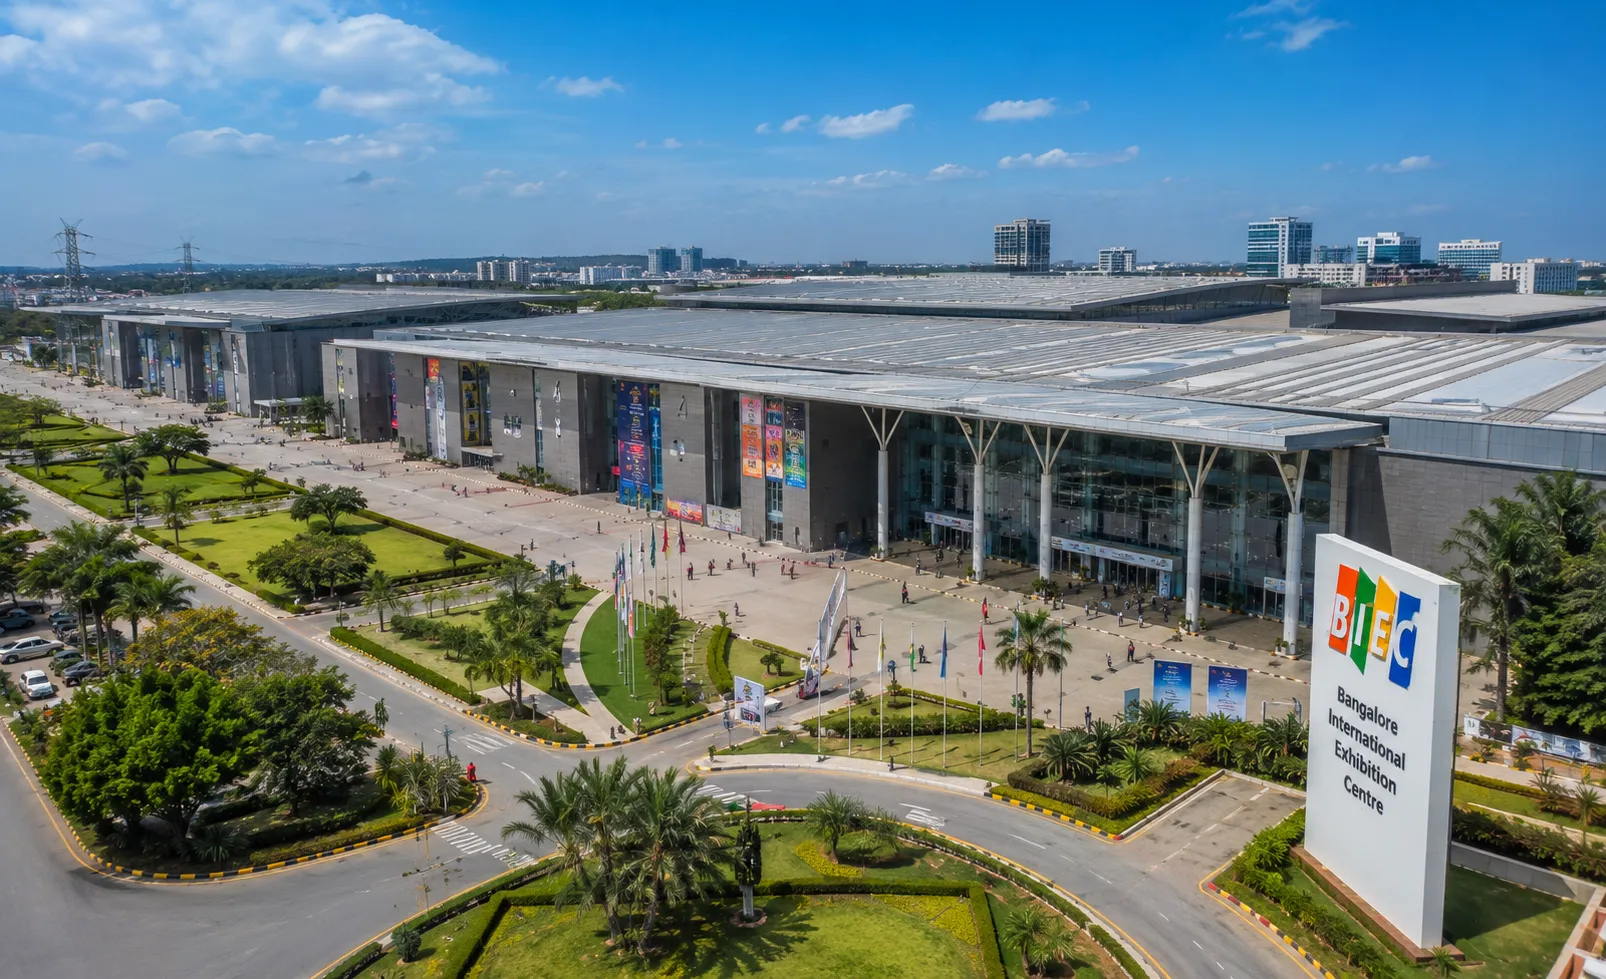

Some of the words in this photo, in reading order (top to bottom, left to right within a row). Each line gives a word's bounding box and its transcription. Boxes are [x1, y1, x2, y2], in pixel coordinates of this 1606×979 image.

[1330, 593, 1420, 668] BIEC
[1337, 685, 1399, 736] Bangalore
[1328, 708, 1406, 771] International
[1334, 739, 1397, 796] Exhibition
[1343, 775, 1384, 815] Centre
